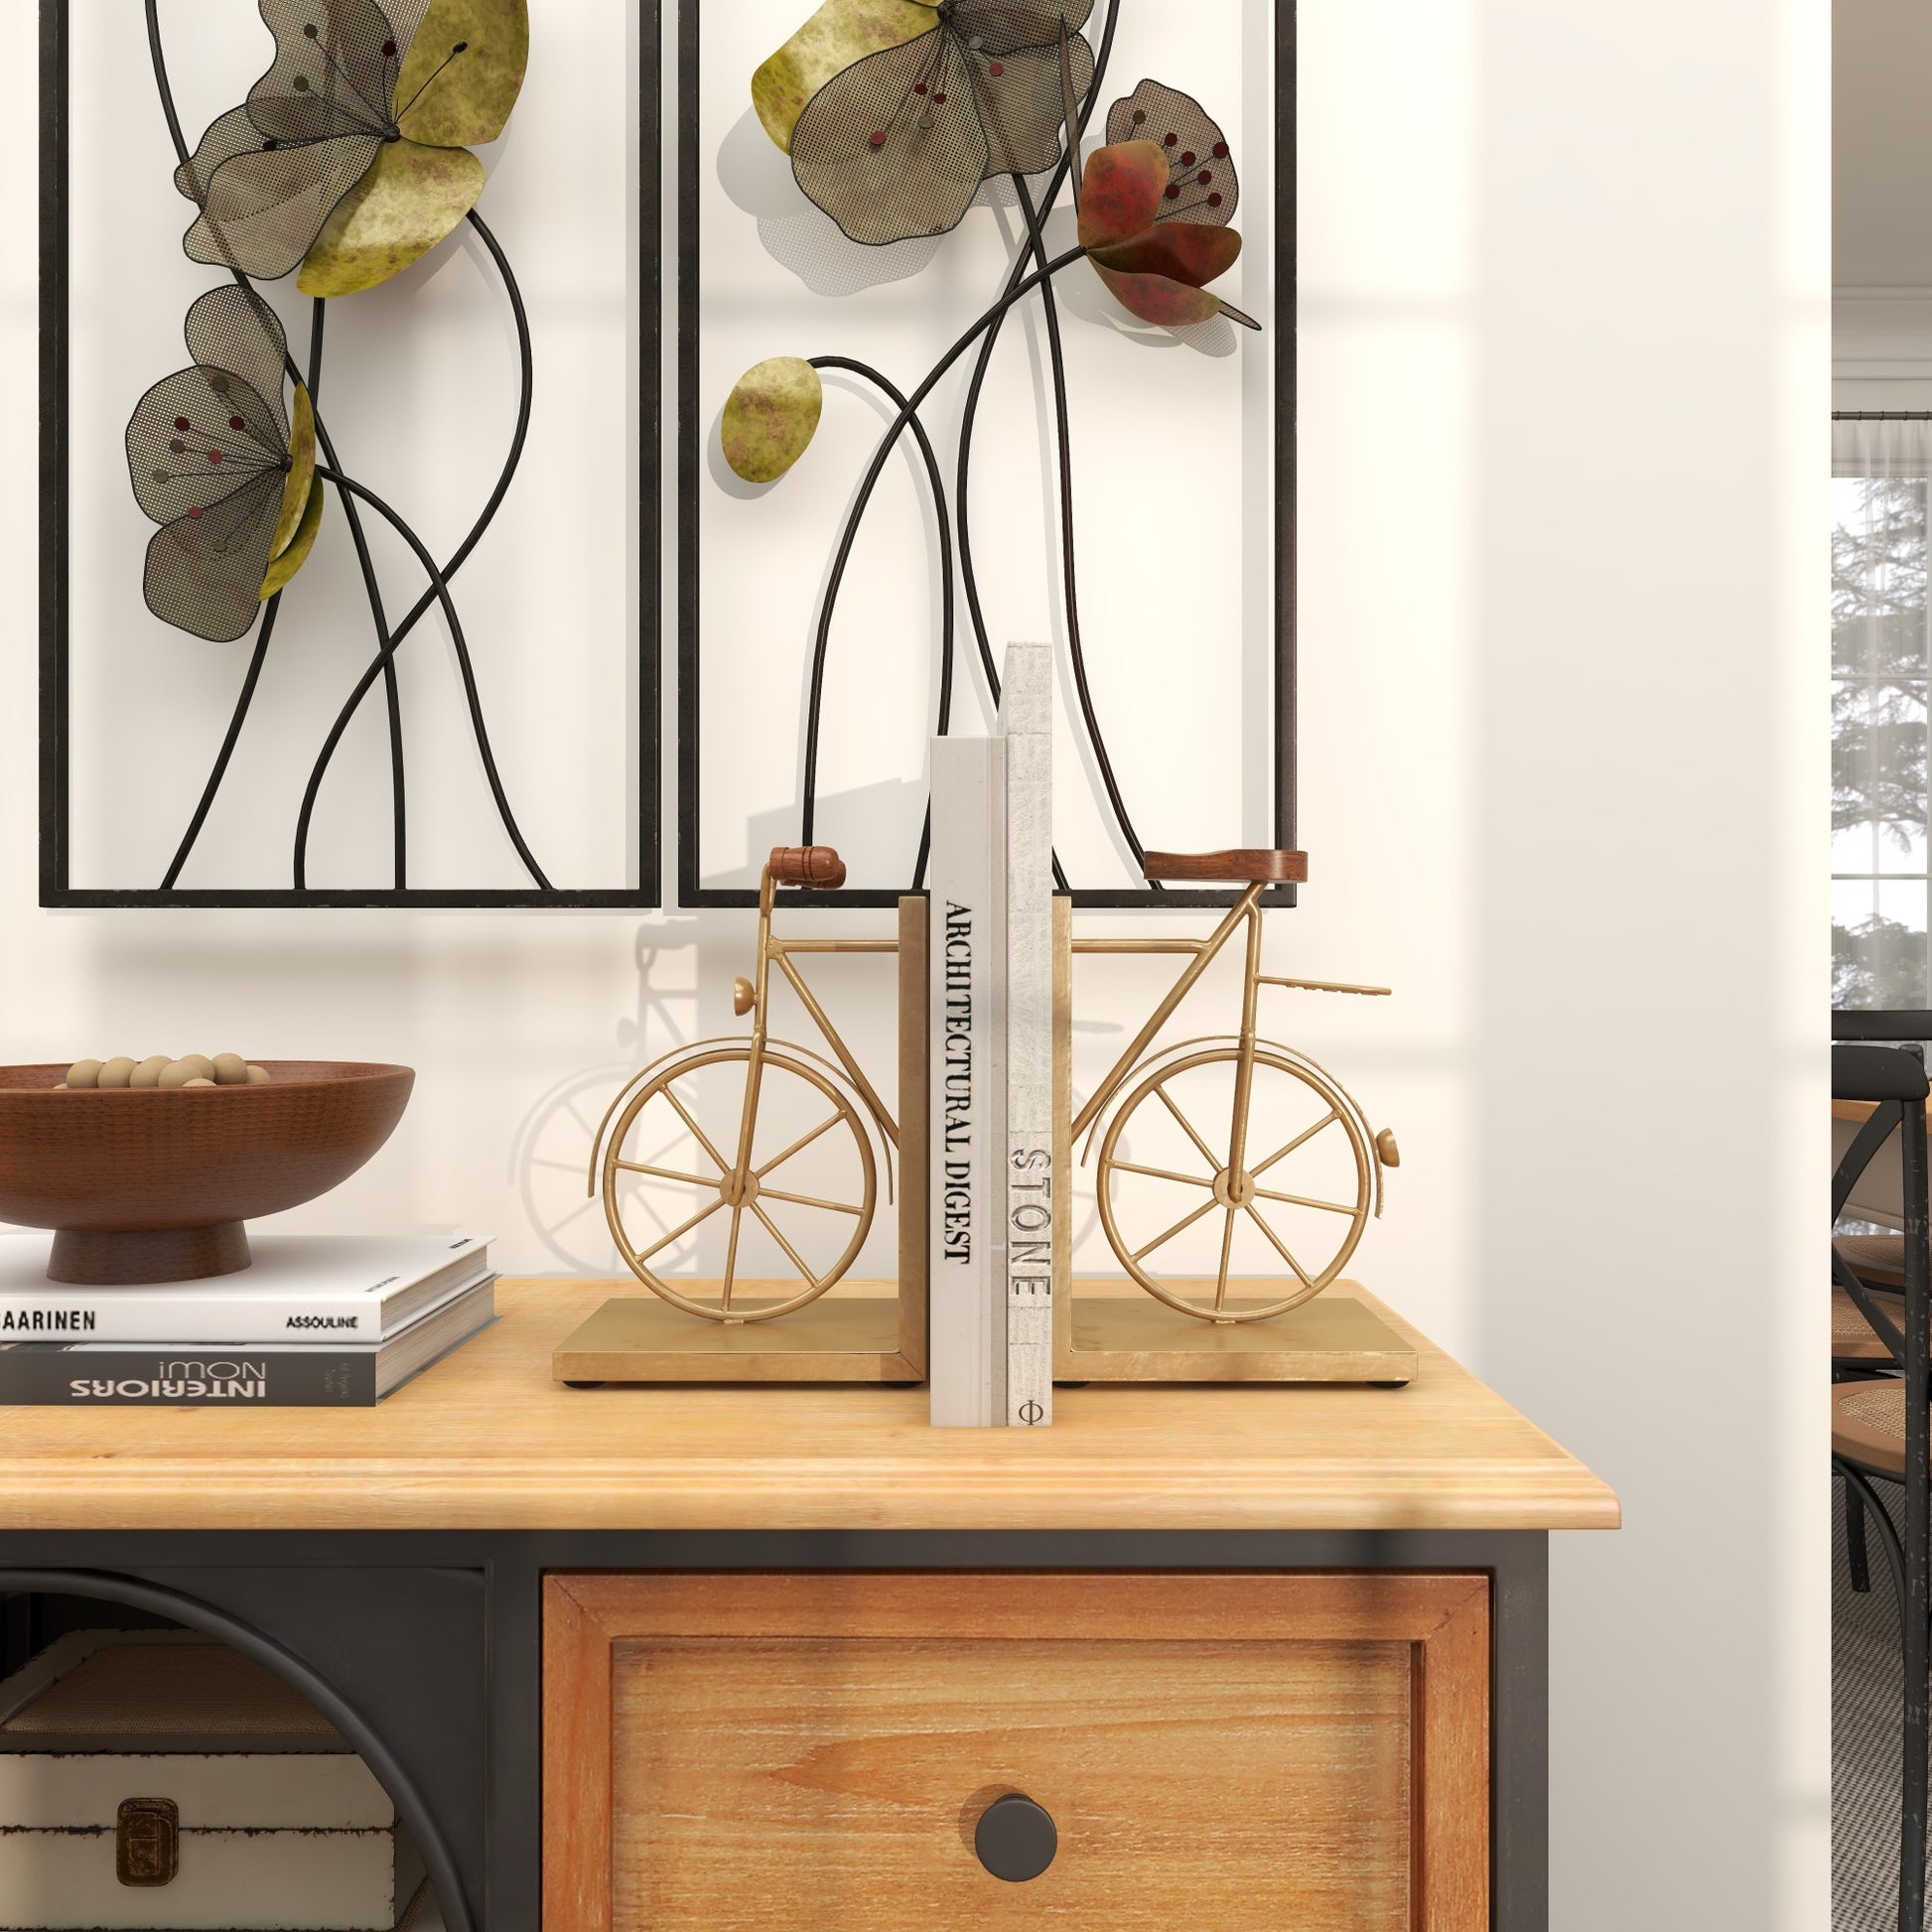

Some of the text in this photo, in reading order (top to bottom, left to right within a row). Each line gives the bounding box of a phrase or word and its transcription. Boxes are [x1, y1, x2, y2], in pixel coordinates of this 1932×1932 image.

[943, 900, 972, 1265] ARCHITECTURAL DIGEST
[1010, 1149, 1051, 1296] STONE
[286, 1315, 358, 1329] ASSOULINE
[69, 1379, 266, 1398] INTERIORS
